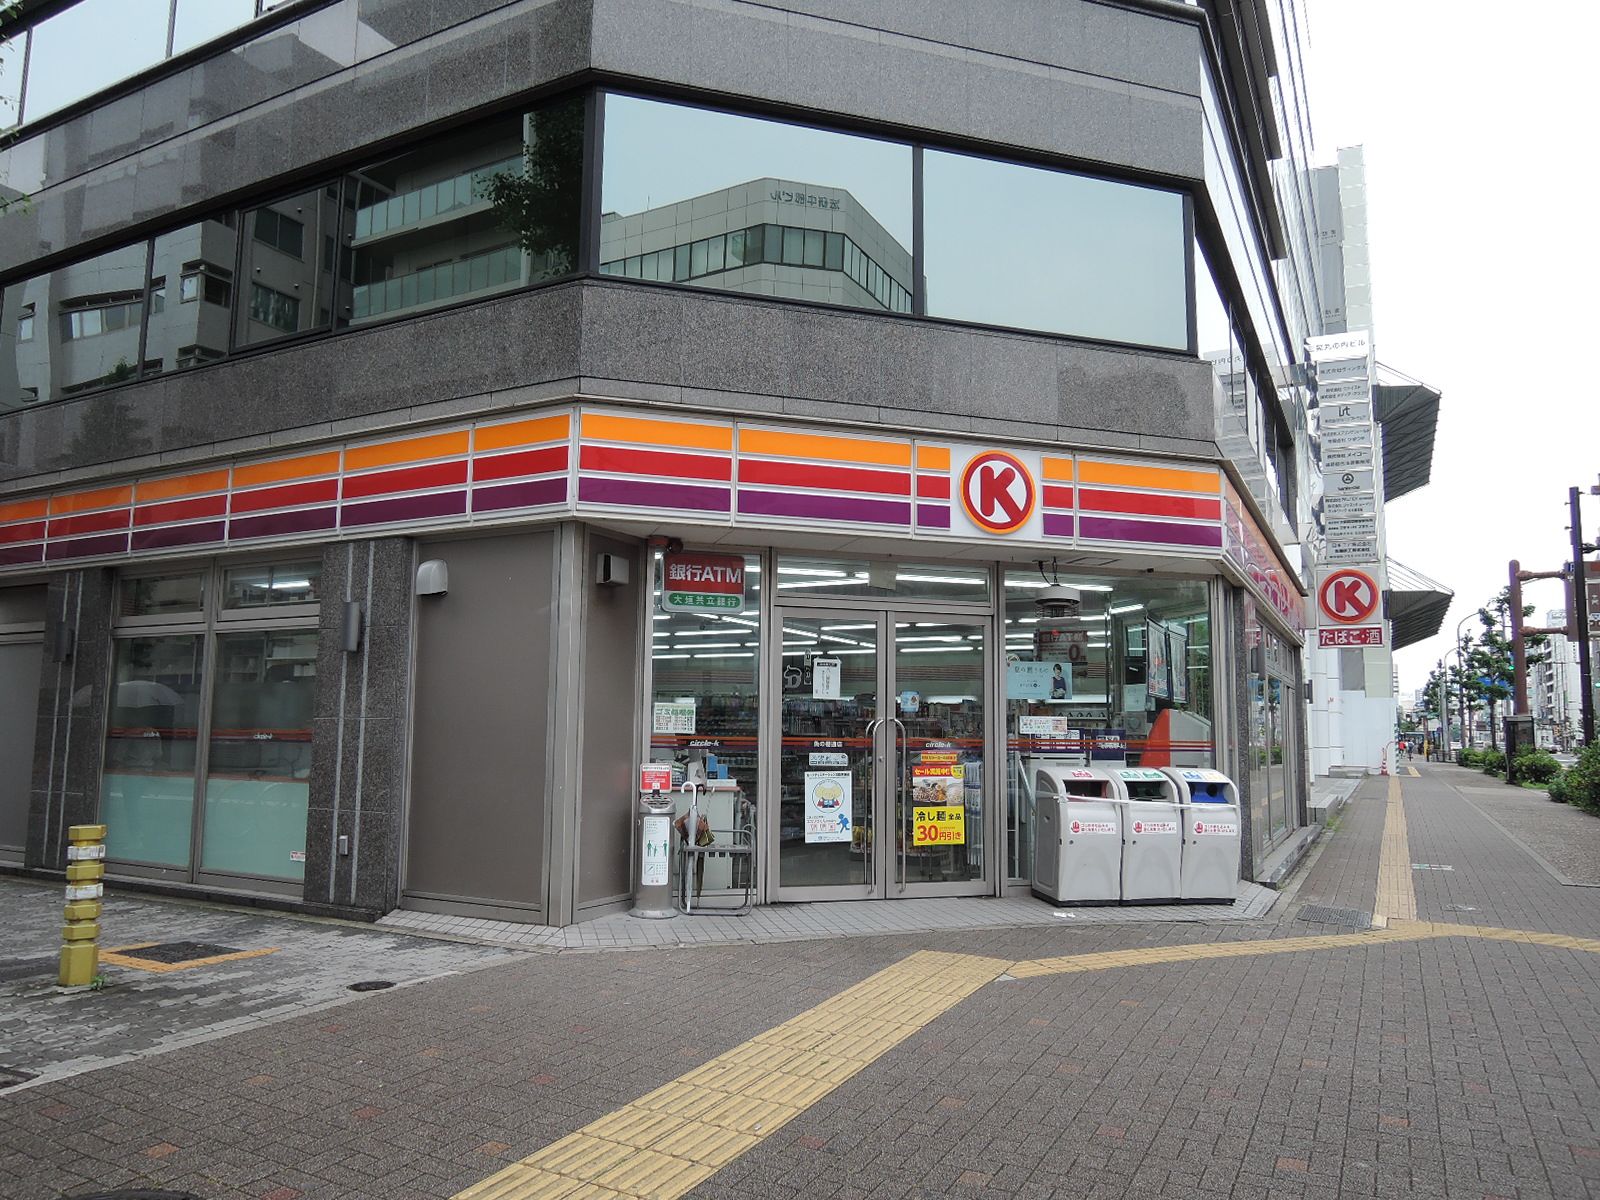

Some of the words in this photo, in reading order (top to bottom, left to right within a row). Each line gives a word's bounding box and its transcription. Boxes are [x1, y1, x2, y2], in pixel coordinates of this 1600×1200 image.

[669, 564, 741, 583] 銀行ATM
[1321, 629, 1380, 644] たばこ・酒
